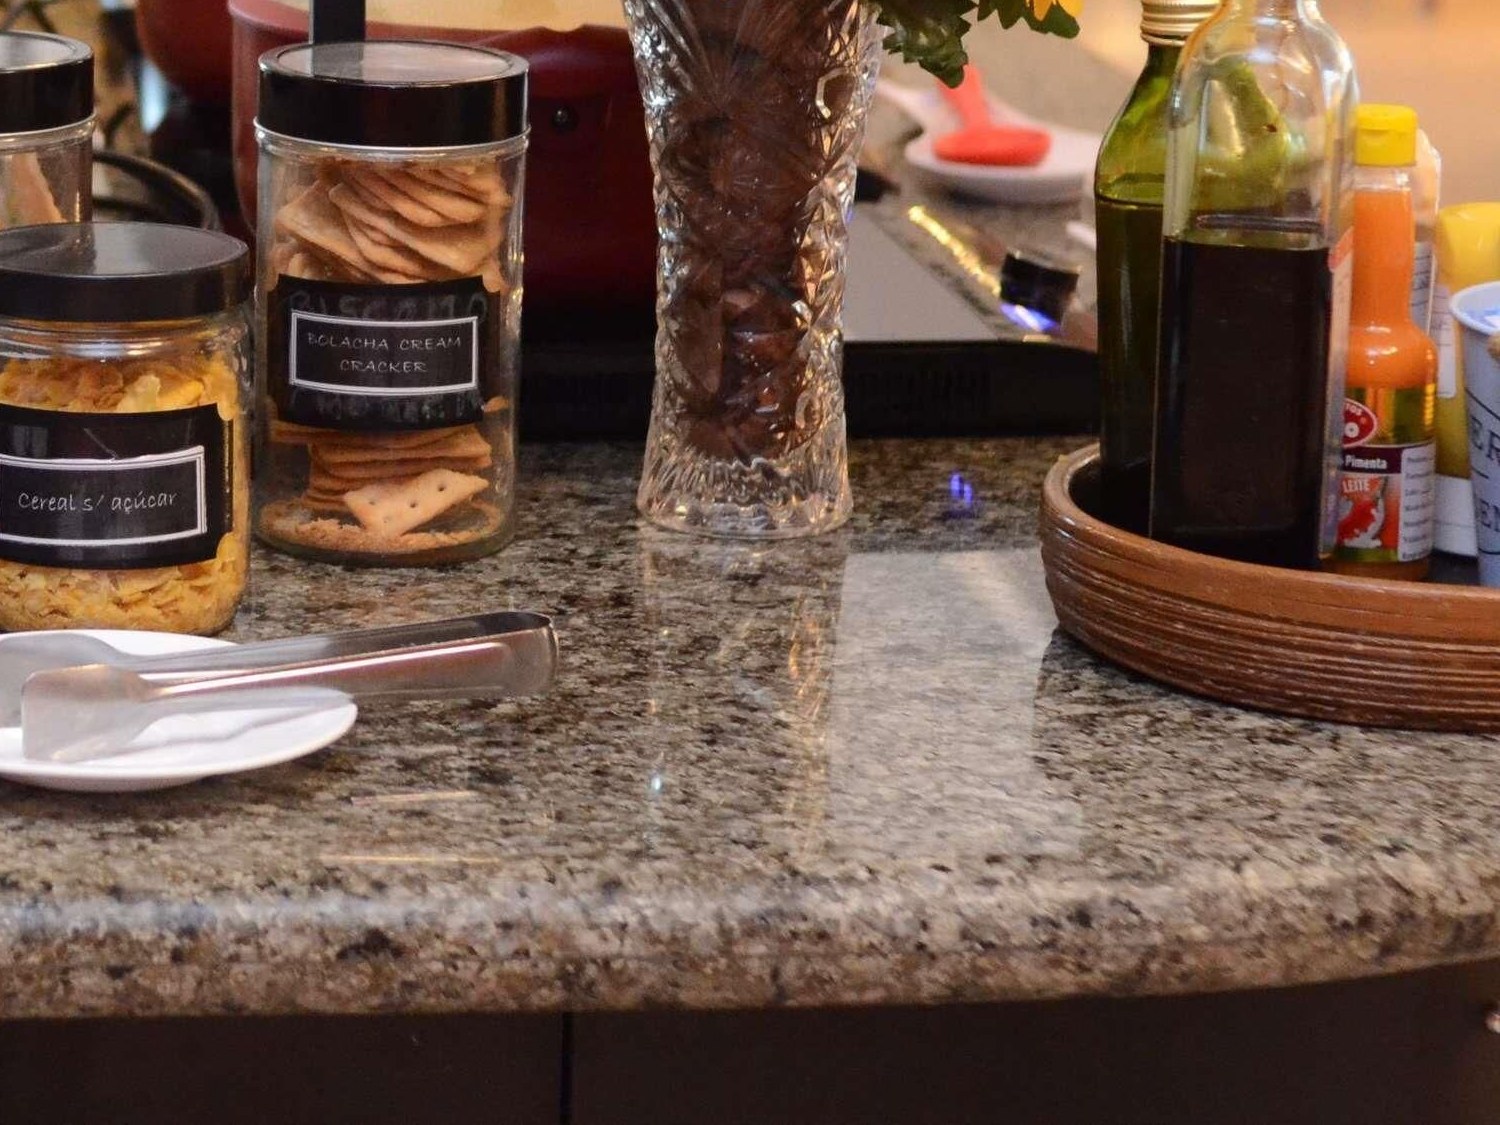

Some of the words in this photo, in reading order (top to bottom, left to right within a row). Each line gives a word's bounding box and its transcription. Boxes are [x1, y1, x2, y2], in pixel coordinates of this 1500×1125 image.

[307, 332, 389, 351] BOLACHA
[399, 336, 462, 352] CREAM
[339, 358, 428, 374] CRACKER
[1344, 455, 1388, 470] Pimenta
[1342, 478, 1371, 493] LEITE
[17, 492, 77, 512] Cereal
[82, 494, 104, 512] s/
[110, 490, 178, 515] açúcar
